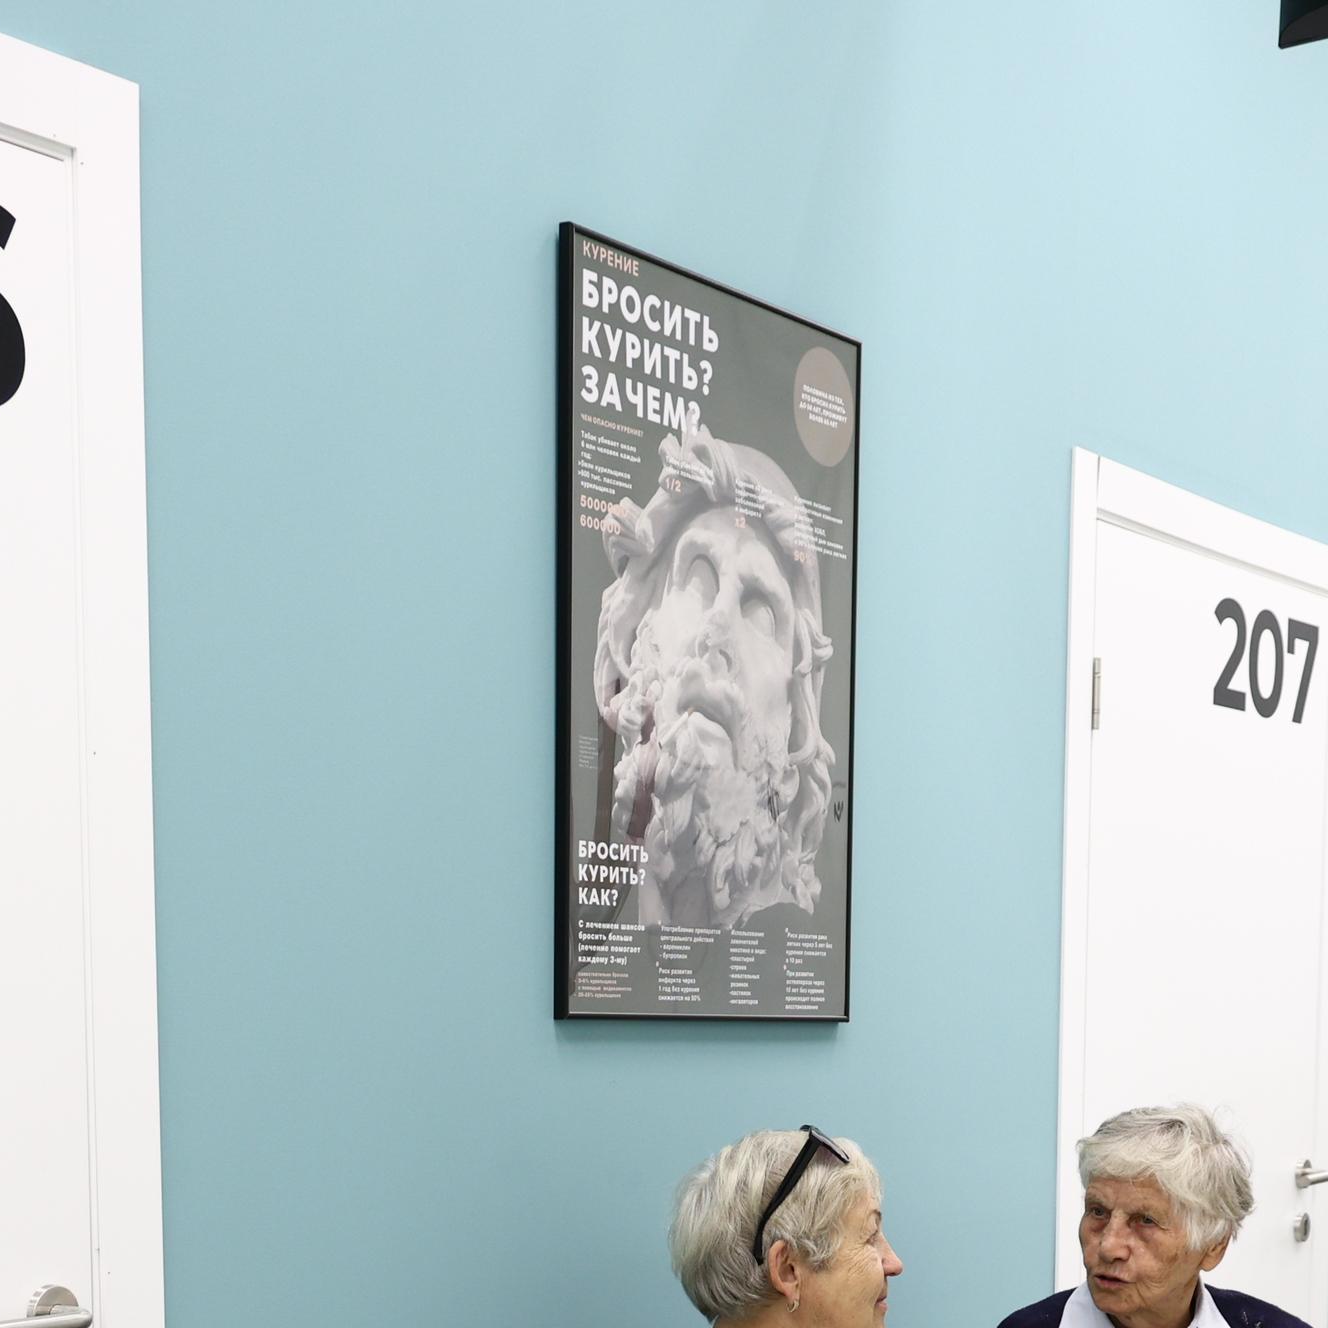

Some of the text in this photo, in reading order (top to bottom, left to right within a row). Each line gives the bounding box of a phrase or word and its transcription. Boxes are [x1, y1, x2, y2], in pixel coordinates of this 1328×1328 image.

[582, 239, 640, 277] КУРЕНИЕ
[581, 268, 719, 353] БРОСИТЬ
[581, 316, 713, 396] КУРИТЬ?
[580, 364, 701, 437] ЗАЧЕМ?
[592, 416, 617, 430] ОПАСНО
[665, 477, 682, 493] 1/2
[1212, 597, 1320, 725] 207
[578, 840, 649, 863] БРОСИТЬ
[578, 864, 646, 886] КУРИТЬ?
[578, 887, 619, 907] КАК?
[578, 920, 646, 932] С лечением шансов
[578, 930, 607, 941] бросить
[578, 942, 641, 954] (лечение помогает
[578, 956, 608, 965] каждому
